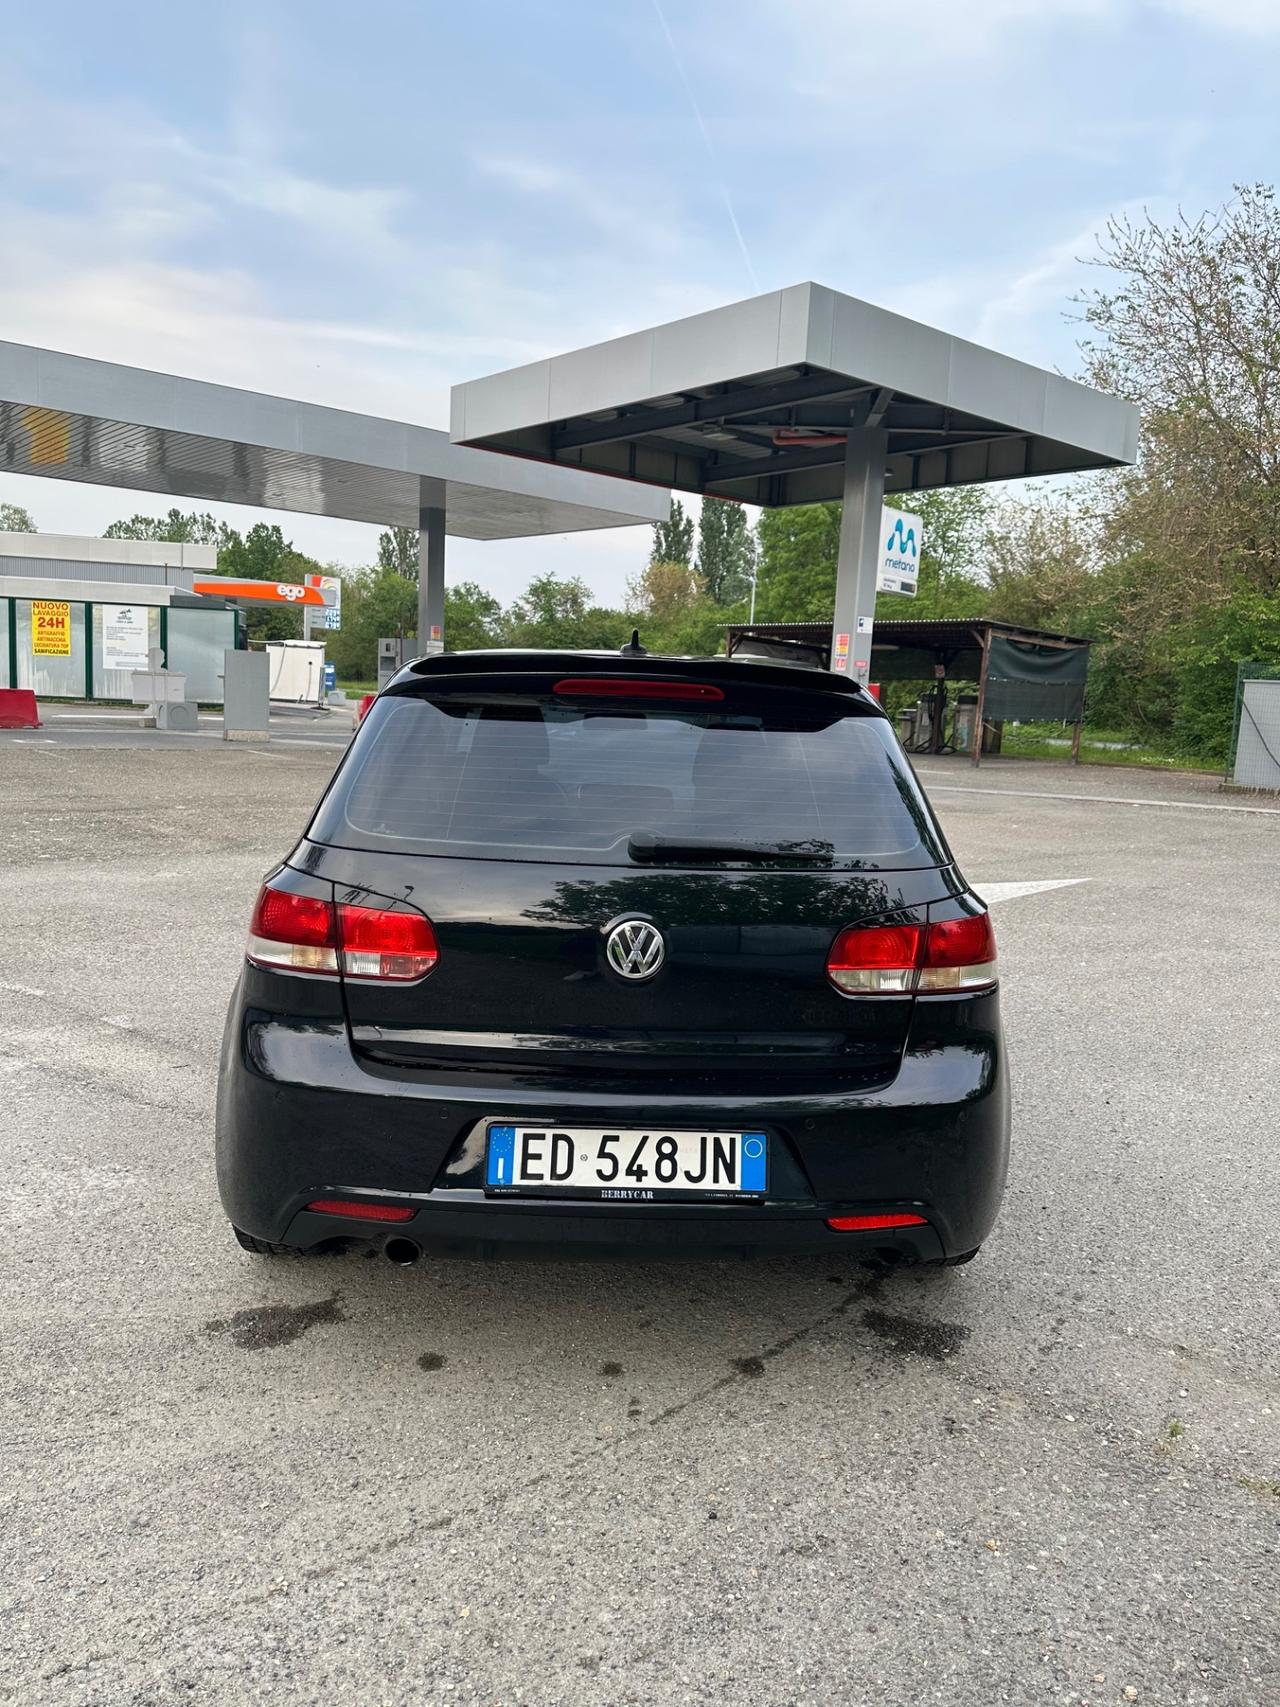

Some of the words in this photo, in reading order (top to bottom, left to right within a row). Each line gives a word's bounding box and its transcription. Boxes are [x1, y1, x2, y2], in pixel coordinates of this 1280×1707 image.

[884, 557, 916, 573] metano
[276, 584, 306, 602] ego
[32, 601, 69, 610] NUOVO
[32, 609, 69, 617] LAVAGGIO
[37, 616, 65, 628] 24H
[520, 1132, 575, 1181] ED
[595, 1134, 737, 1185] 548JN
[600, 1189, 655, 1200] BERRYCAR
